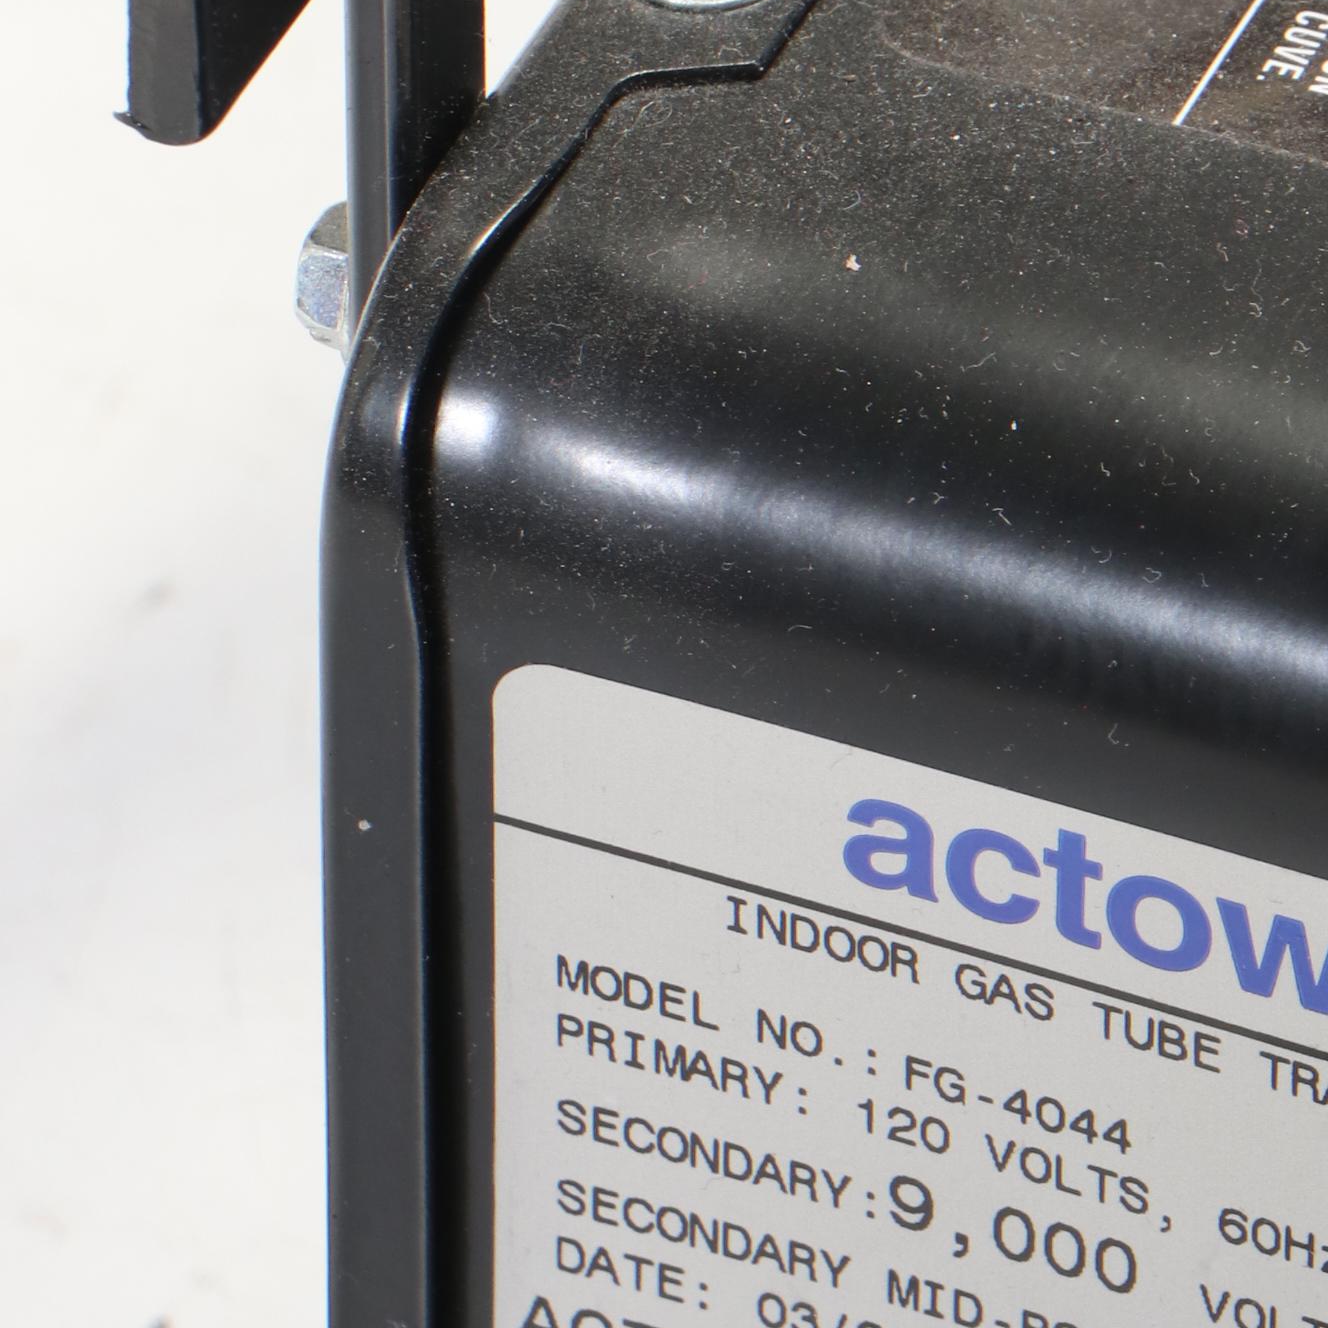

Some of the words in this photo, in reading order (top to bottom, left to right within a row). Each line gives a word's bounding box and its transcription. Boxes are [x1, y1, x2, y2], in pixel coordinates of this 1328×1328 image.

[556, 954, 720, 1031] MODEL
[905, 1054, 1132, 1155] FG-4044
[726, 895, 920, 985] INDOOR
[954, 963, 1054, 1021] GAS
[1092, 1001, 1221, 1074] TUBE
[557, 1013, 807, 1115] PRIMARY:
[857, 1098, 950, 1155] 120
[984, 1133, 1171, 1233] VOLTS,
[556, 1235, 708, 1310] DATE:
[557, 1179, 851, 1289] SECONDARY
